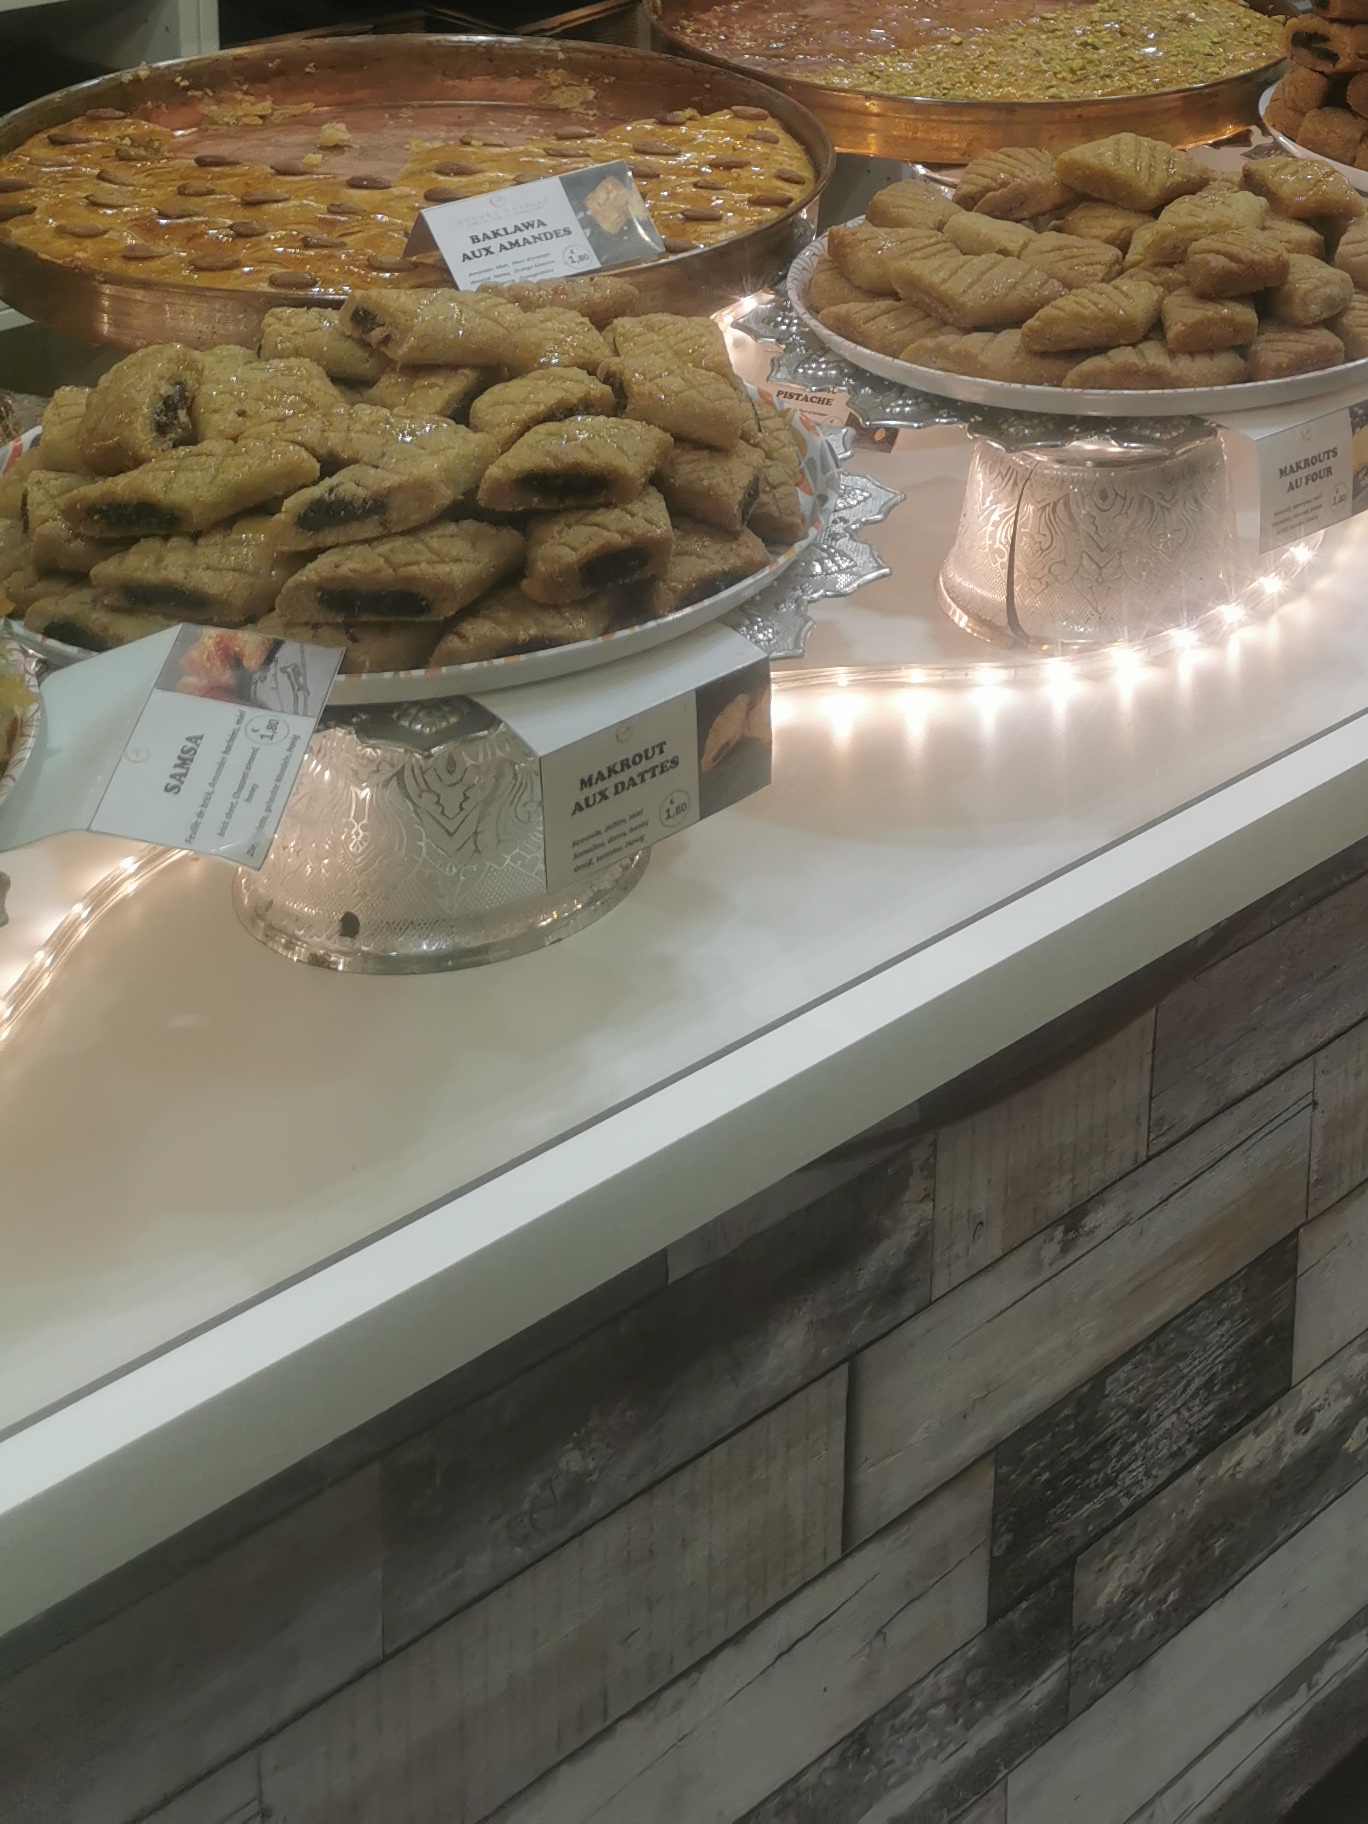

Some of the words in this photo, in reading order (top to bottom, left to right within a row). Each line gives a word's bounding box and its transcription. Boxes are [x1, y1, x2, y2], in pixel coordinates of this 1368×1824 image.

[461, 246, 495, 262] AUX
[499, 227, 573, 253] AMANDES
[469, 219, 548, 244] BAKLAWA
[569, 253, 590, 265] 1,80
[776, 390, 834, 406] PISTACHE
[1278, 447, 1338, 478] MAKROUTS
[1287, 479, 1303, 493] AU
[1304, 466, 1333, 486] FOUR
[260, 718, 280, 741] 1,80
[164, 733, 204, 796] SAMSA
[579, 741, 667, 791] MAKROUT
[571, 788, 609, 816] AUX
[613, 755, 680, 796] DATTES
[664, 802, 688, 820] 1,80
